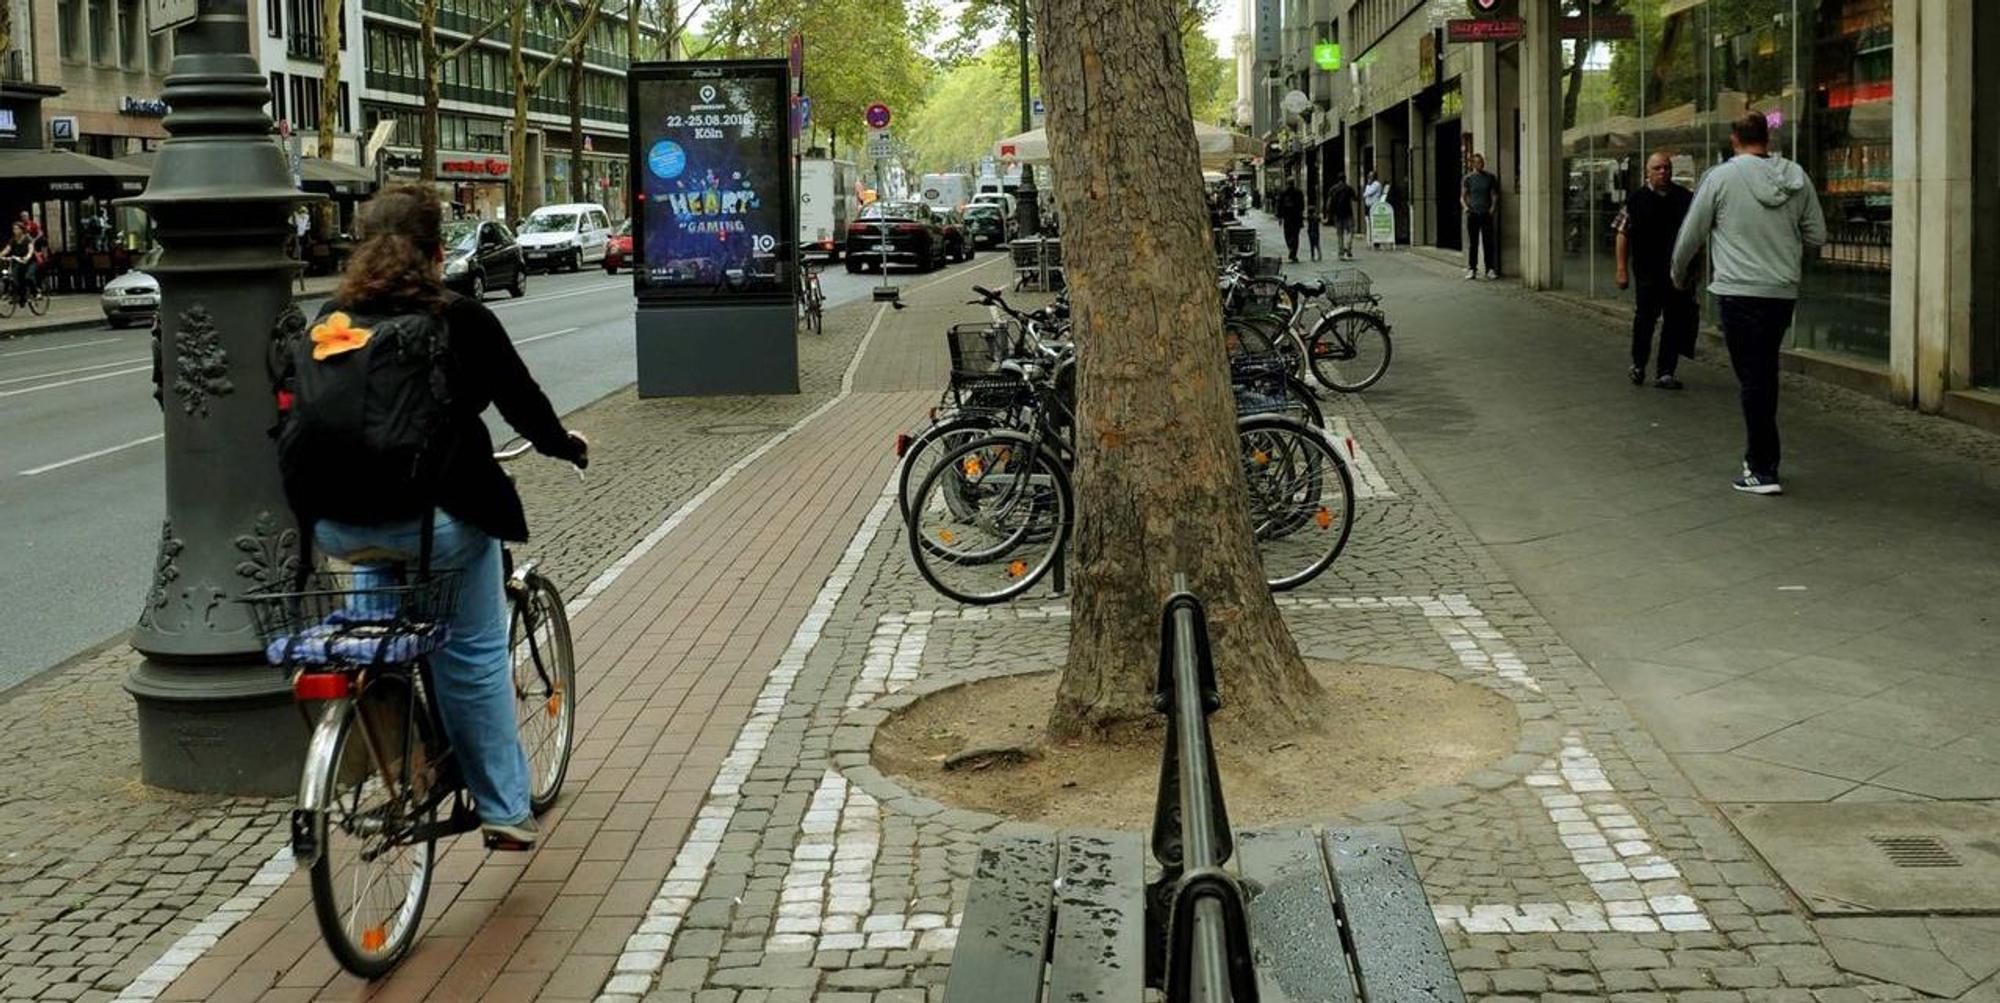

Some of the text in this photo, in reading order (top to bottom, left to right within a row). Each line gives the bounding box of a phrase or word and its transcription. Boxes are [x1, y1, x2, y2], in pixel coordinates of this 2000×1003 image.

[694, 128, 724, 139] Köln
[669, 189, 755, 215] HEART
[688, 220, 745, 233] GAMING
